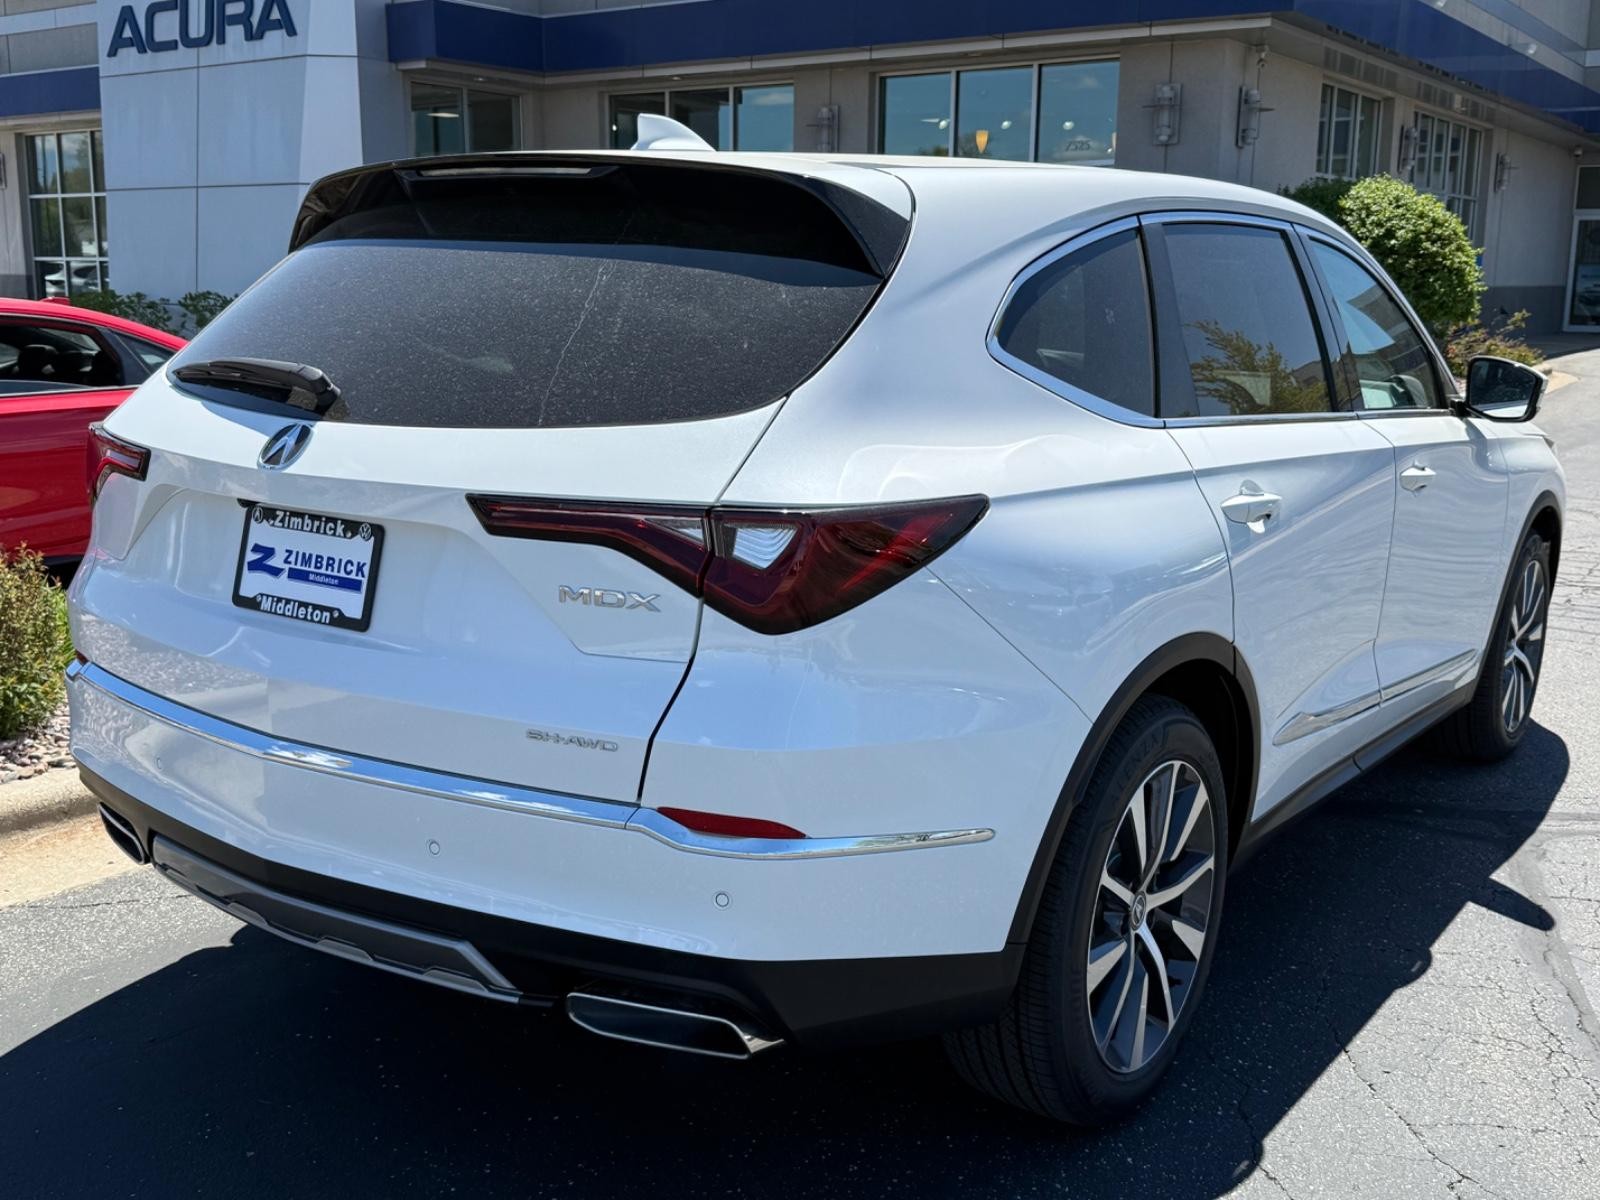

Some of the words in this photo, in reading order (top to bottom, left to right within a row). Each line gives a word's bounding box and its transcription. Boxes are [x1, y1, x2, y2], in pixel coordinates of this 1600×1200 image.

[107, 0, 298, 58] ACURA
[275, 510, 346, 538] Zimbrick
[283, 549, 367, 578] ZIMBRICK
[309, 573, 339, 585] Middleton
[260, 595, 331, 624] Middleton
[559, 584, 661, 613] MDX
